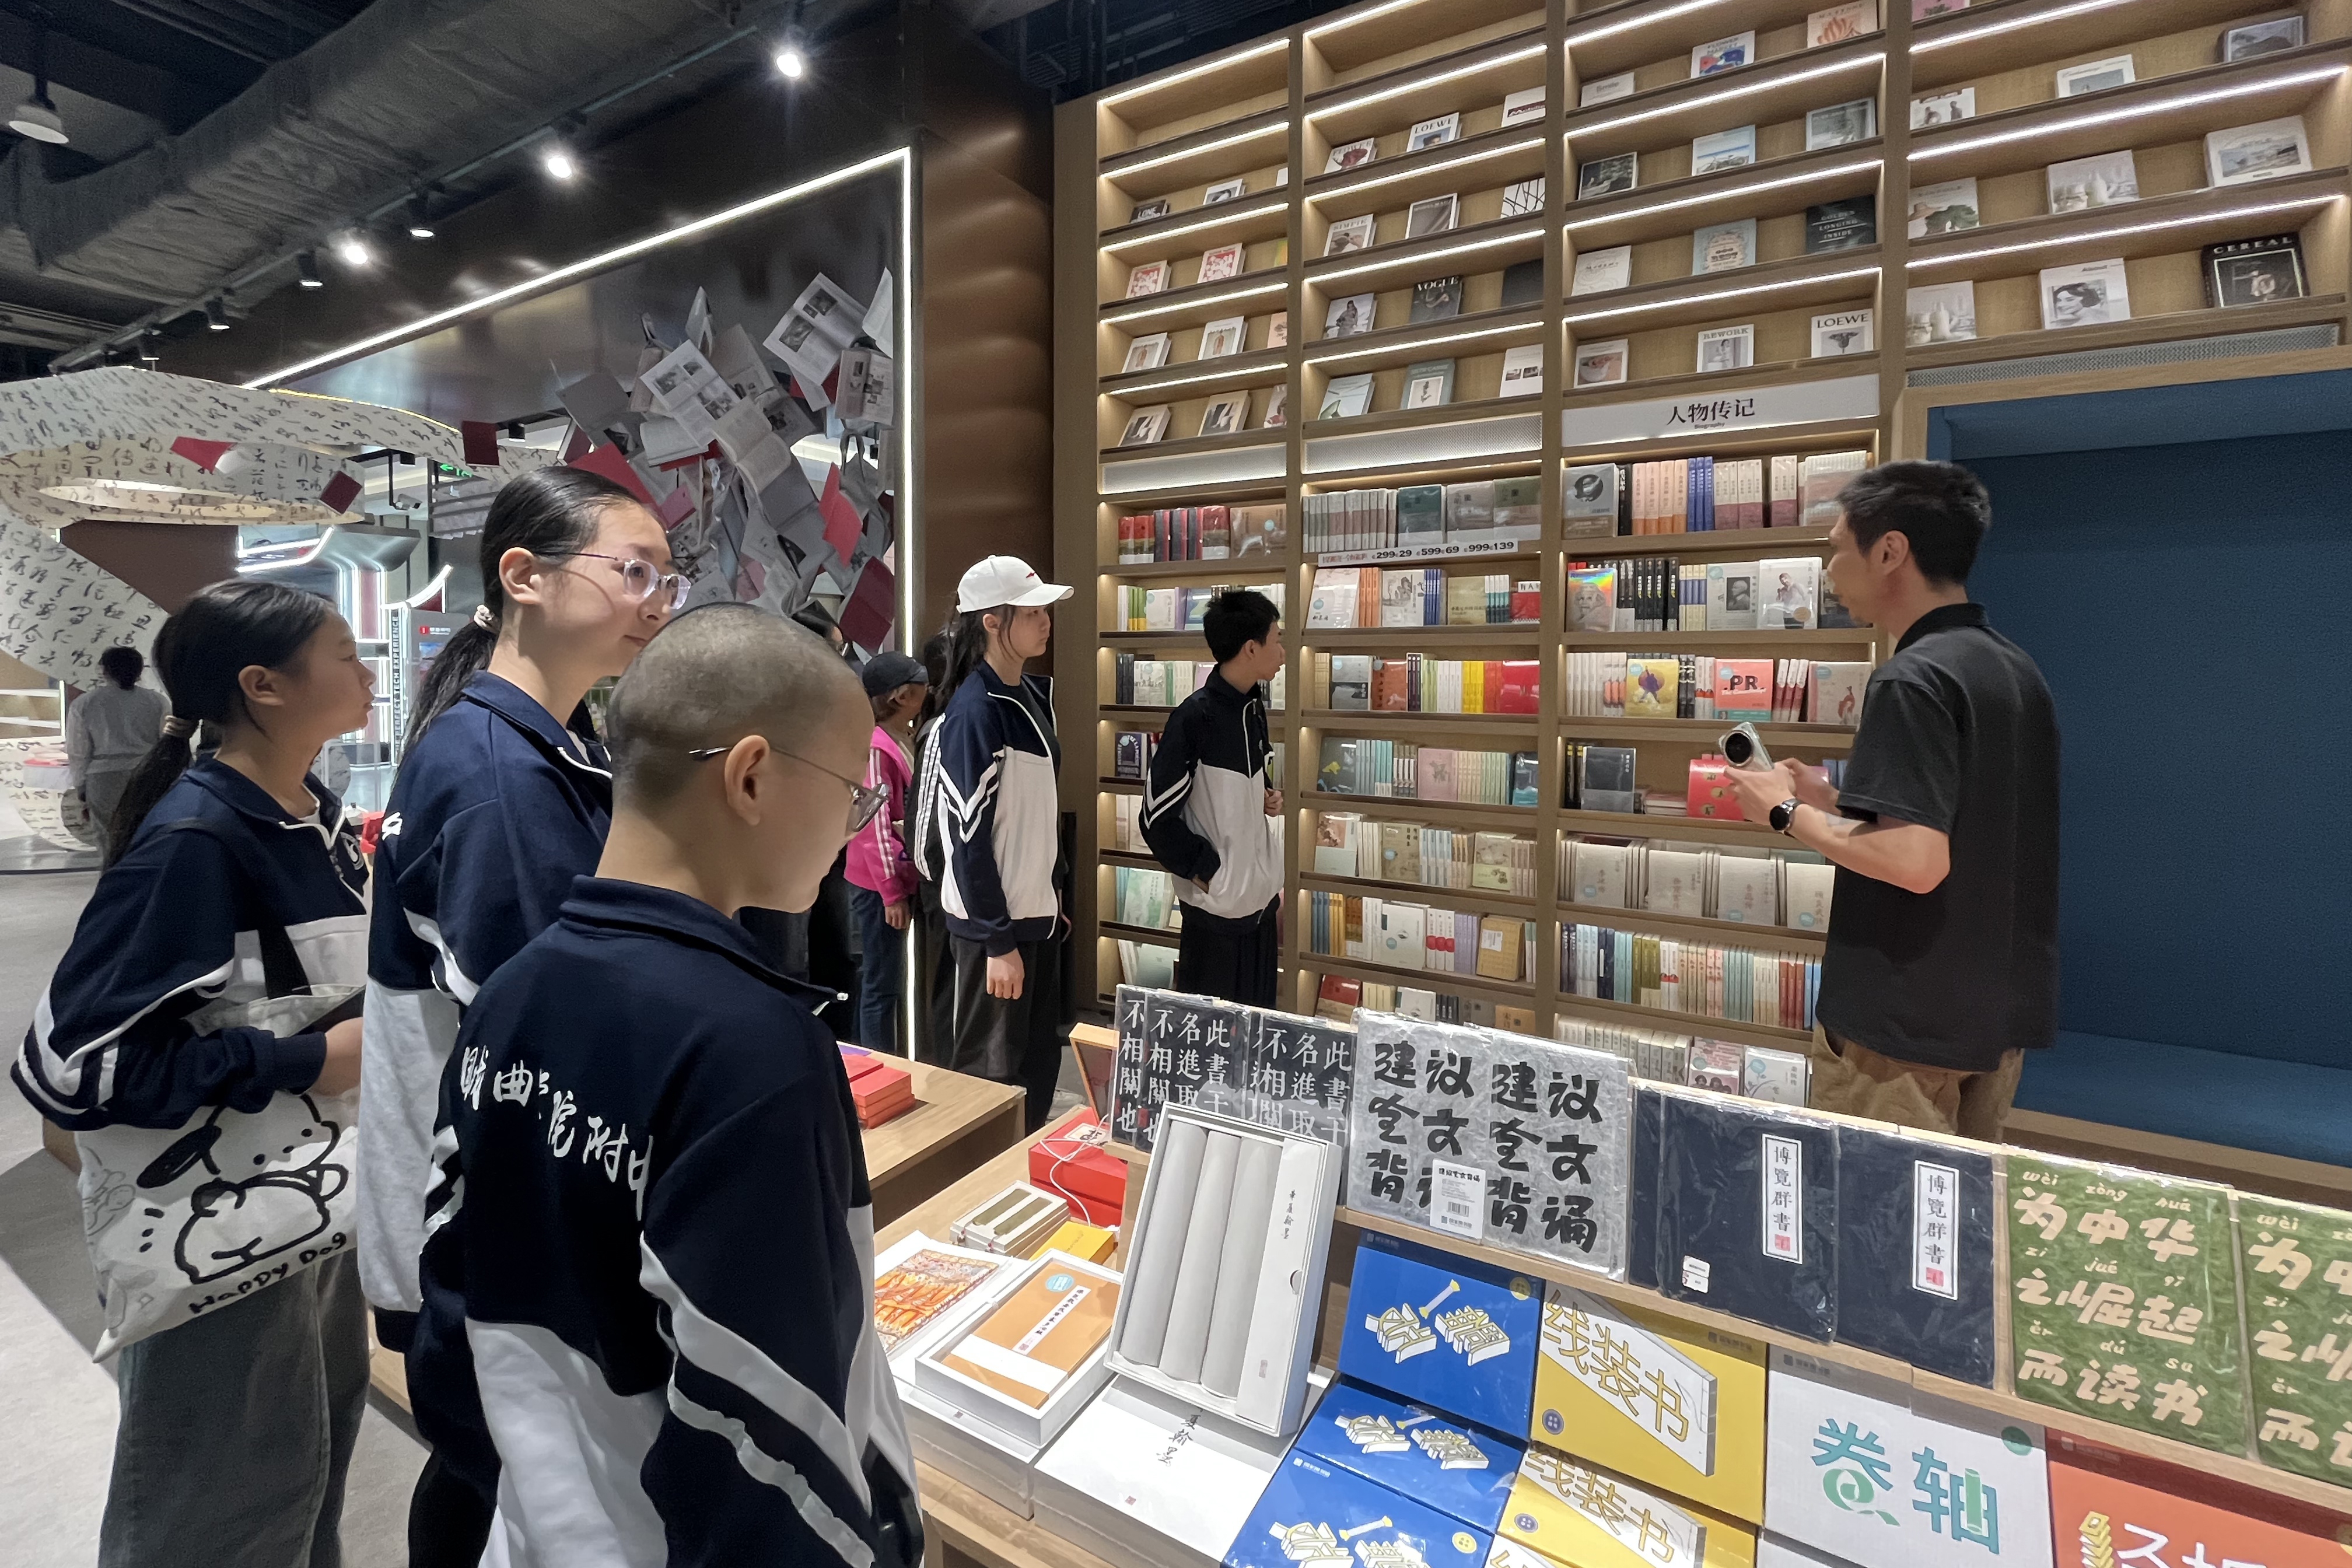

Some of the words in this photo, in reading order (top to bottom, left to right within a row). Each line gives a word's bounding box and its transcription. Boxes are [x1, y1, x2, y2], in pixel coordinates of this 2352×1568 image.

[1414, 116, 1454, 134] LOEWE
[2213, 235, 2294, 256] CEREAL
[1416, 275, 1460, 293] VOGUE
[1703, 327, 1749, 340] REWORK
[1817, 313, 1868, 329] LOEWE
[1666, 398, 1755, 425] 人物传记
[1729, 675, 1759, 691] PR
[2022, 1170, 2059, 1187] wèi
[2085, 1182, 2128, 1203] zòng
[1486, 1176, 1598, 1254] 背诵
[2013, 1186, 2200, 1264] 为中华
[2256, 1213, 2301, 1231] wèi
[299, 1232, 348, 1265] Dog
[2084, 1257, 2119, 1276] jué
[2015, 1267, 2204, 1346] 之崛起
[2099, 1339, 2127, 1356] dú
[1541, 1288, 1689, 1443] 线装书
[2017, 1348, 2209, 1427] 而读书
[1811, 1418, 2001, 1556] 卷轴
[1524, 1441, 1675, 1564] 线装书
